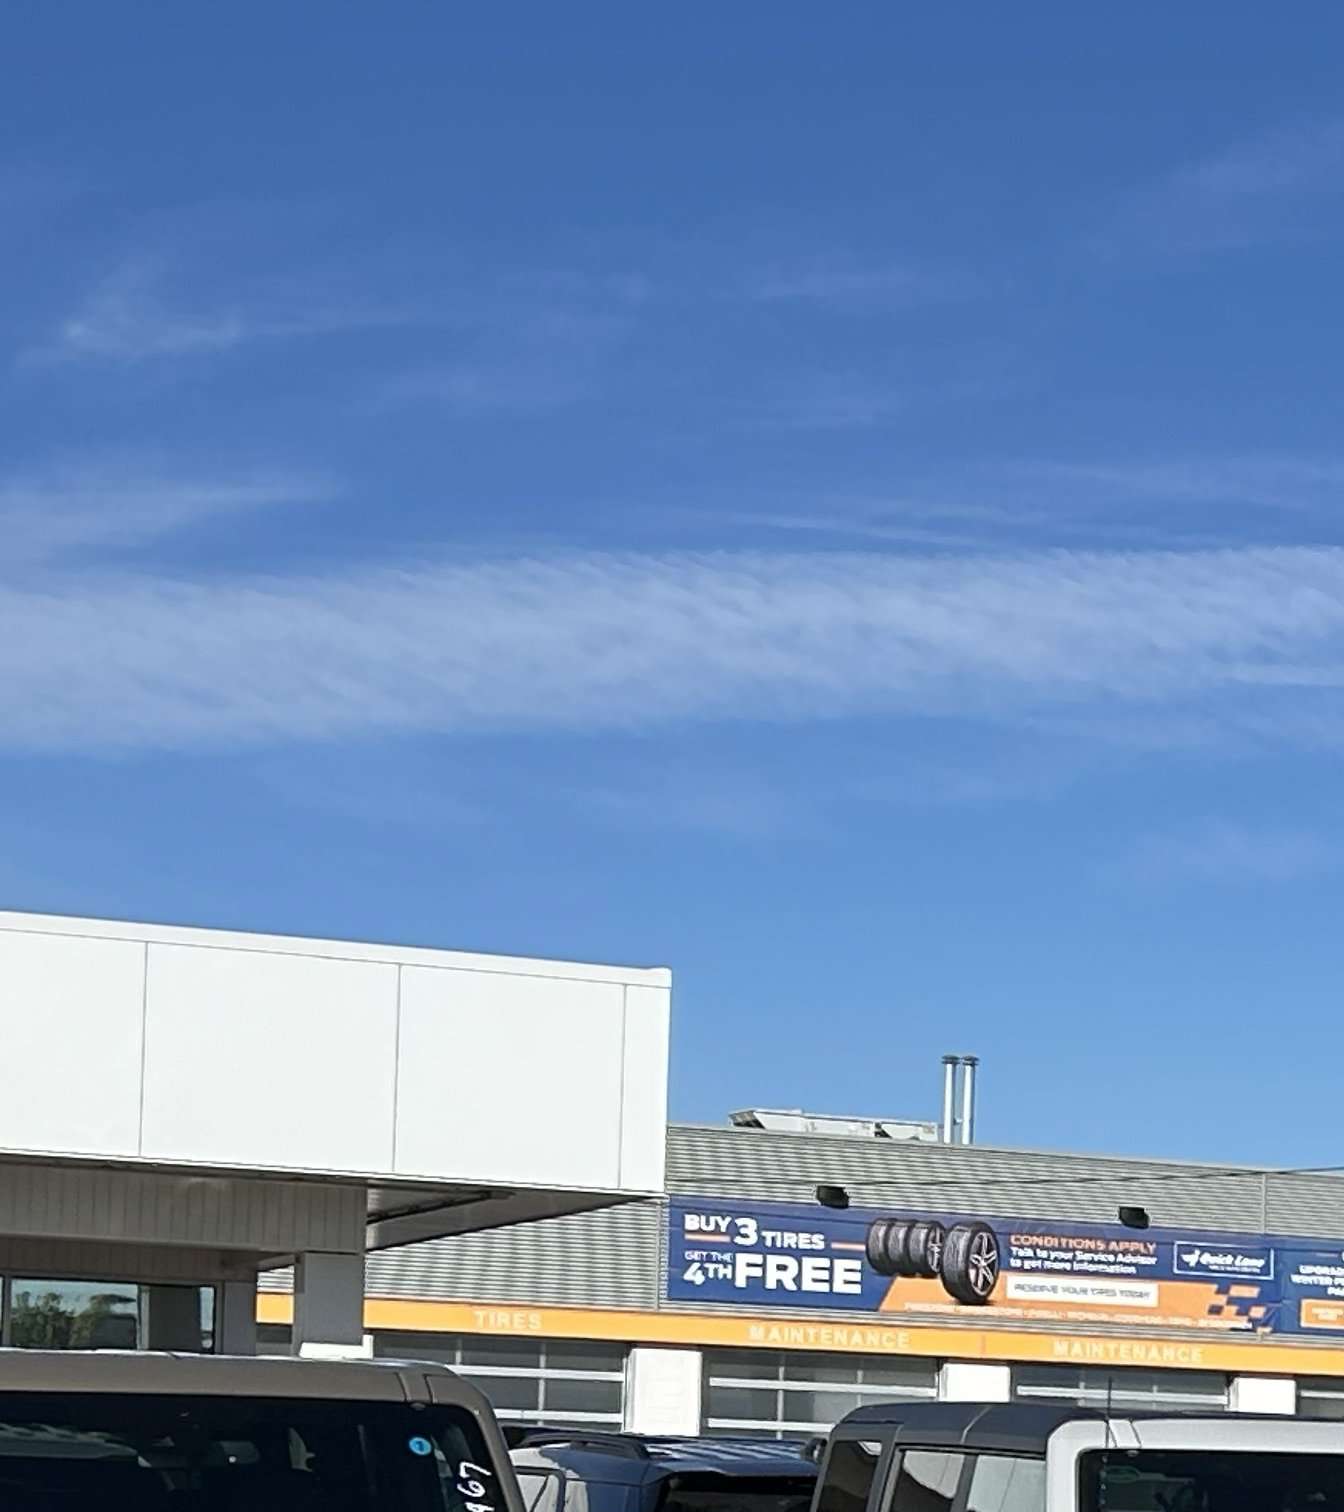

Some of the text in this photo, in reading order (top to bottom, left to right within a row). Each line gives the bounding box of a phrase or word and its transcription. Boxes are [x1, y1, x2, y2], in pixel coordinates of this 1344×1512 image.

[684, 1214, 825, 1250] BUY 3 TIRES
[1010, 1234, 1157, 1254] CONDITIONS APPLY
[684, 1251, 733, 1262] GET THE
[683, 1262, 733, 1285] 4TH
[734, 1253, 862, 1294] FREE
[473, 1311, 542, 1330] TIRES
[748, 1324, 912, 1349] MAINTENANCE
[1053, 1339, 1204, 1364] MAINTENANCE
